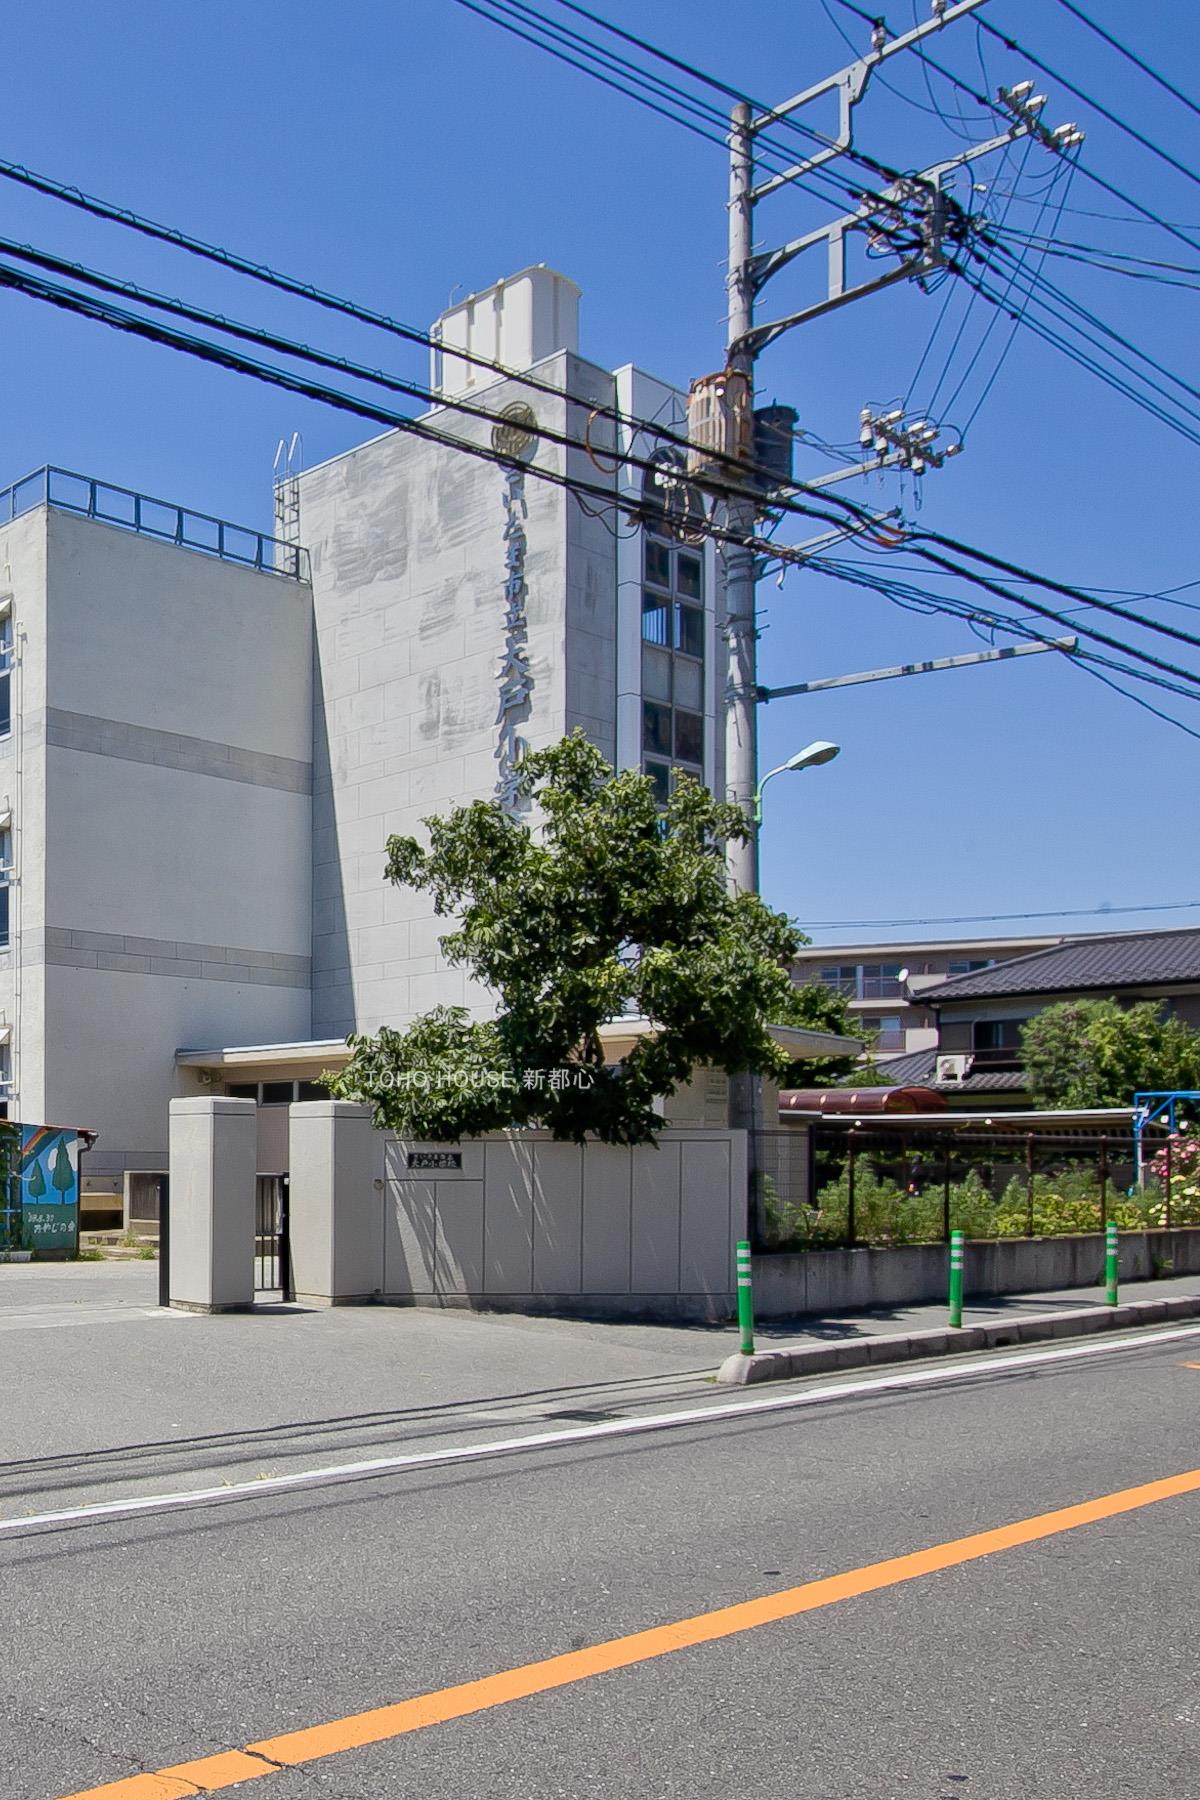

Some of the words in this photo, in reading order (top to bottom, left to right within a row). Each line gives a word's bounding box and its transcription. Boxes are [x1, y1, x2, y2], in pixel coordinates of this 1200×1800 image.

[492, 464, 529, 824] いたま市立大戸小学
